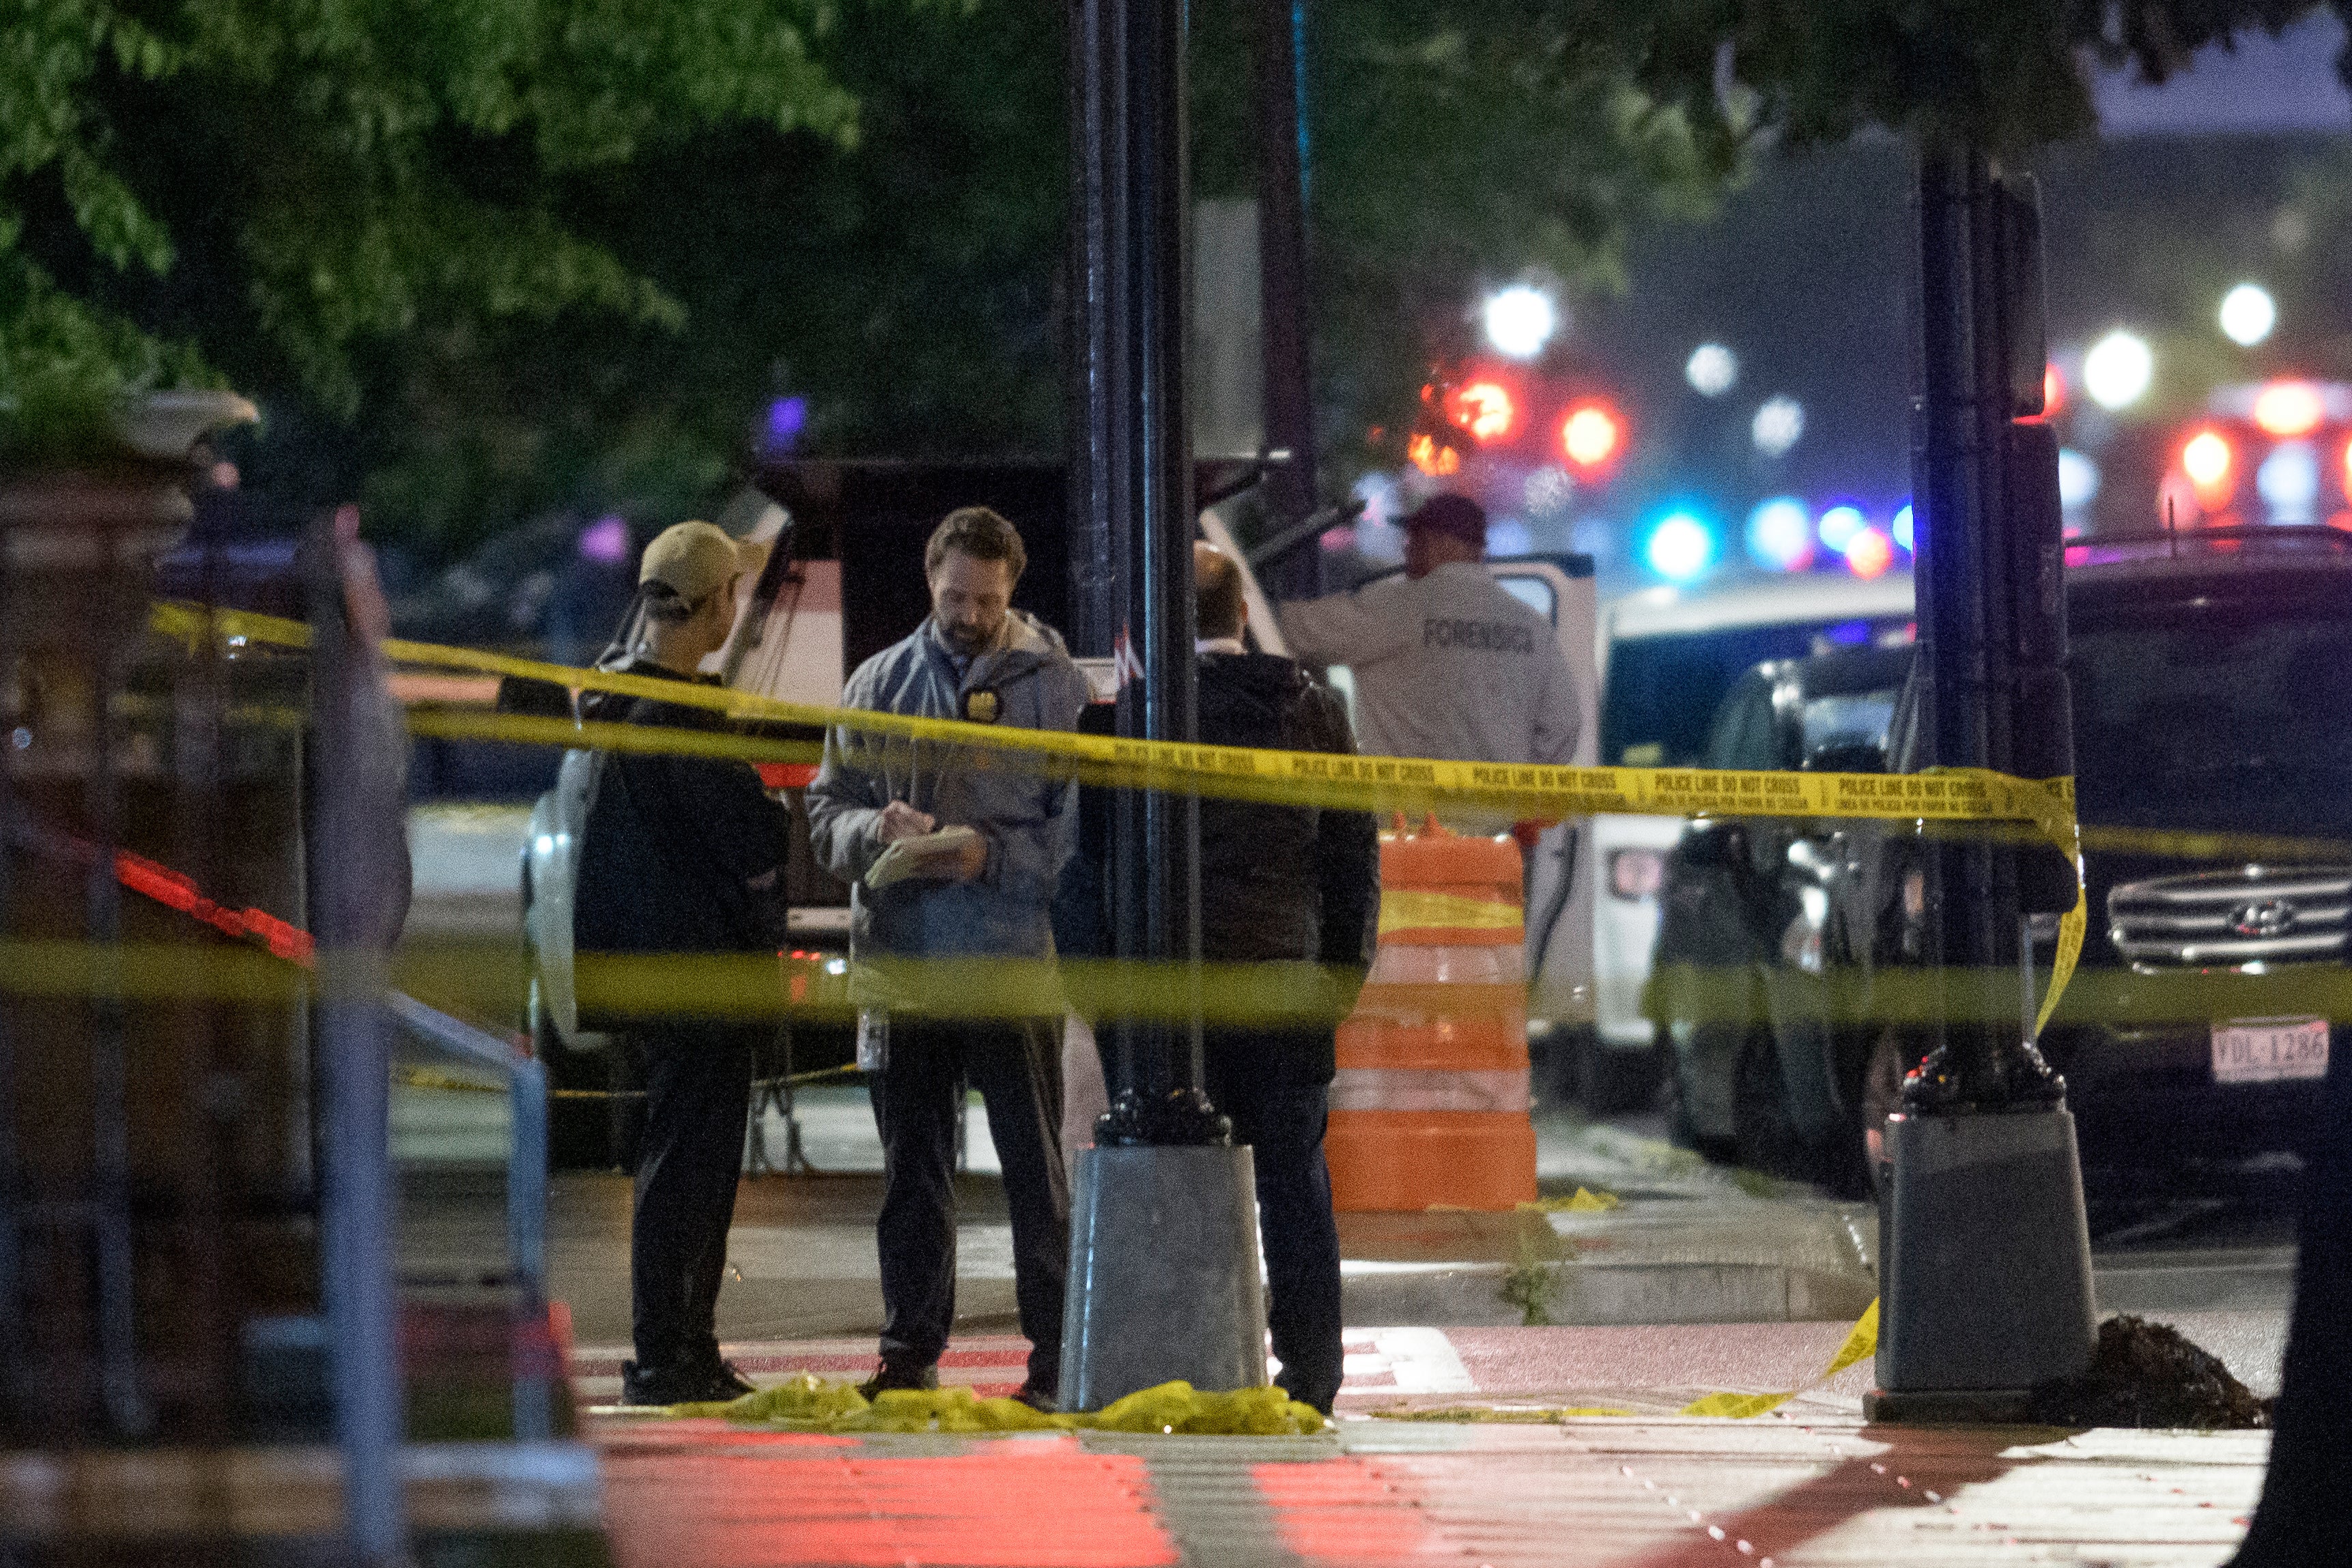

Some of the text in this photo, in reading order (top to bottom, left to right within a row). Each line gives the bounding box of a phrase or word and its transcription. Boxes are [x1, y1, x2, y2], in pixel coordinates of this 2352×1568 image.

[1292, 758, 1435, 781] POLICE LINE DO NOT CROSS
[1473, 767, 1617, 789] POLICE LINE DO NOT CROSS
[1655, 773, 1691, 792] POLICE
[1696, 775, 1718, 793] LINE
[1722, 775, 1737, 793] DO
[1740, 776, 1761, 793] NOT
[1764, 777, 1800, 794] CROSS
[1839, 778, 1876, 795] POLICE
[1880, 780, 1903, 797] LINE
[1907, 780, 1922, 797] DO
[1925, 781, 1945, 797] NOT
[1949, 781, 1987, 797] CROSS
